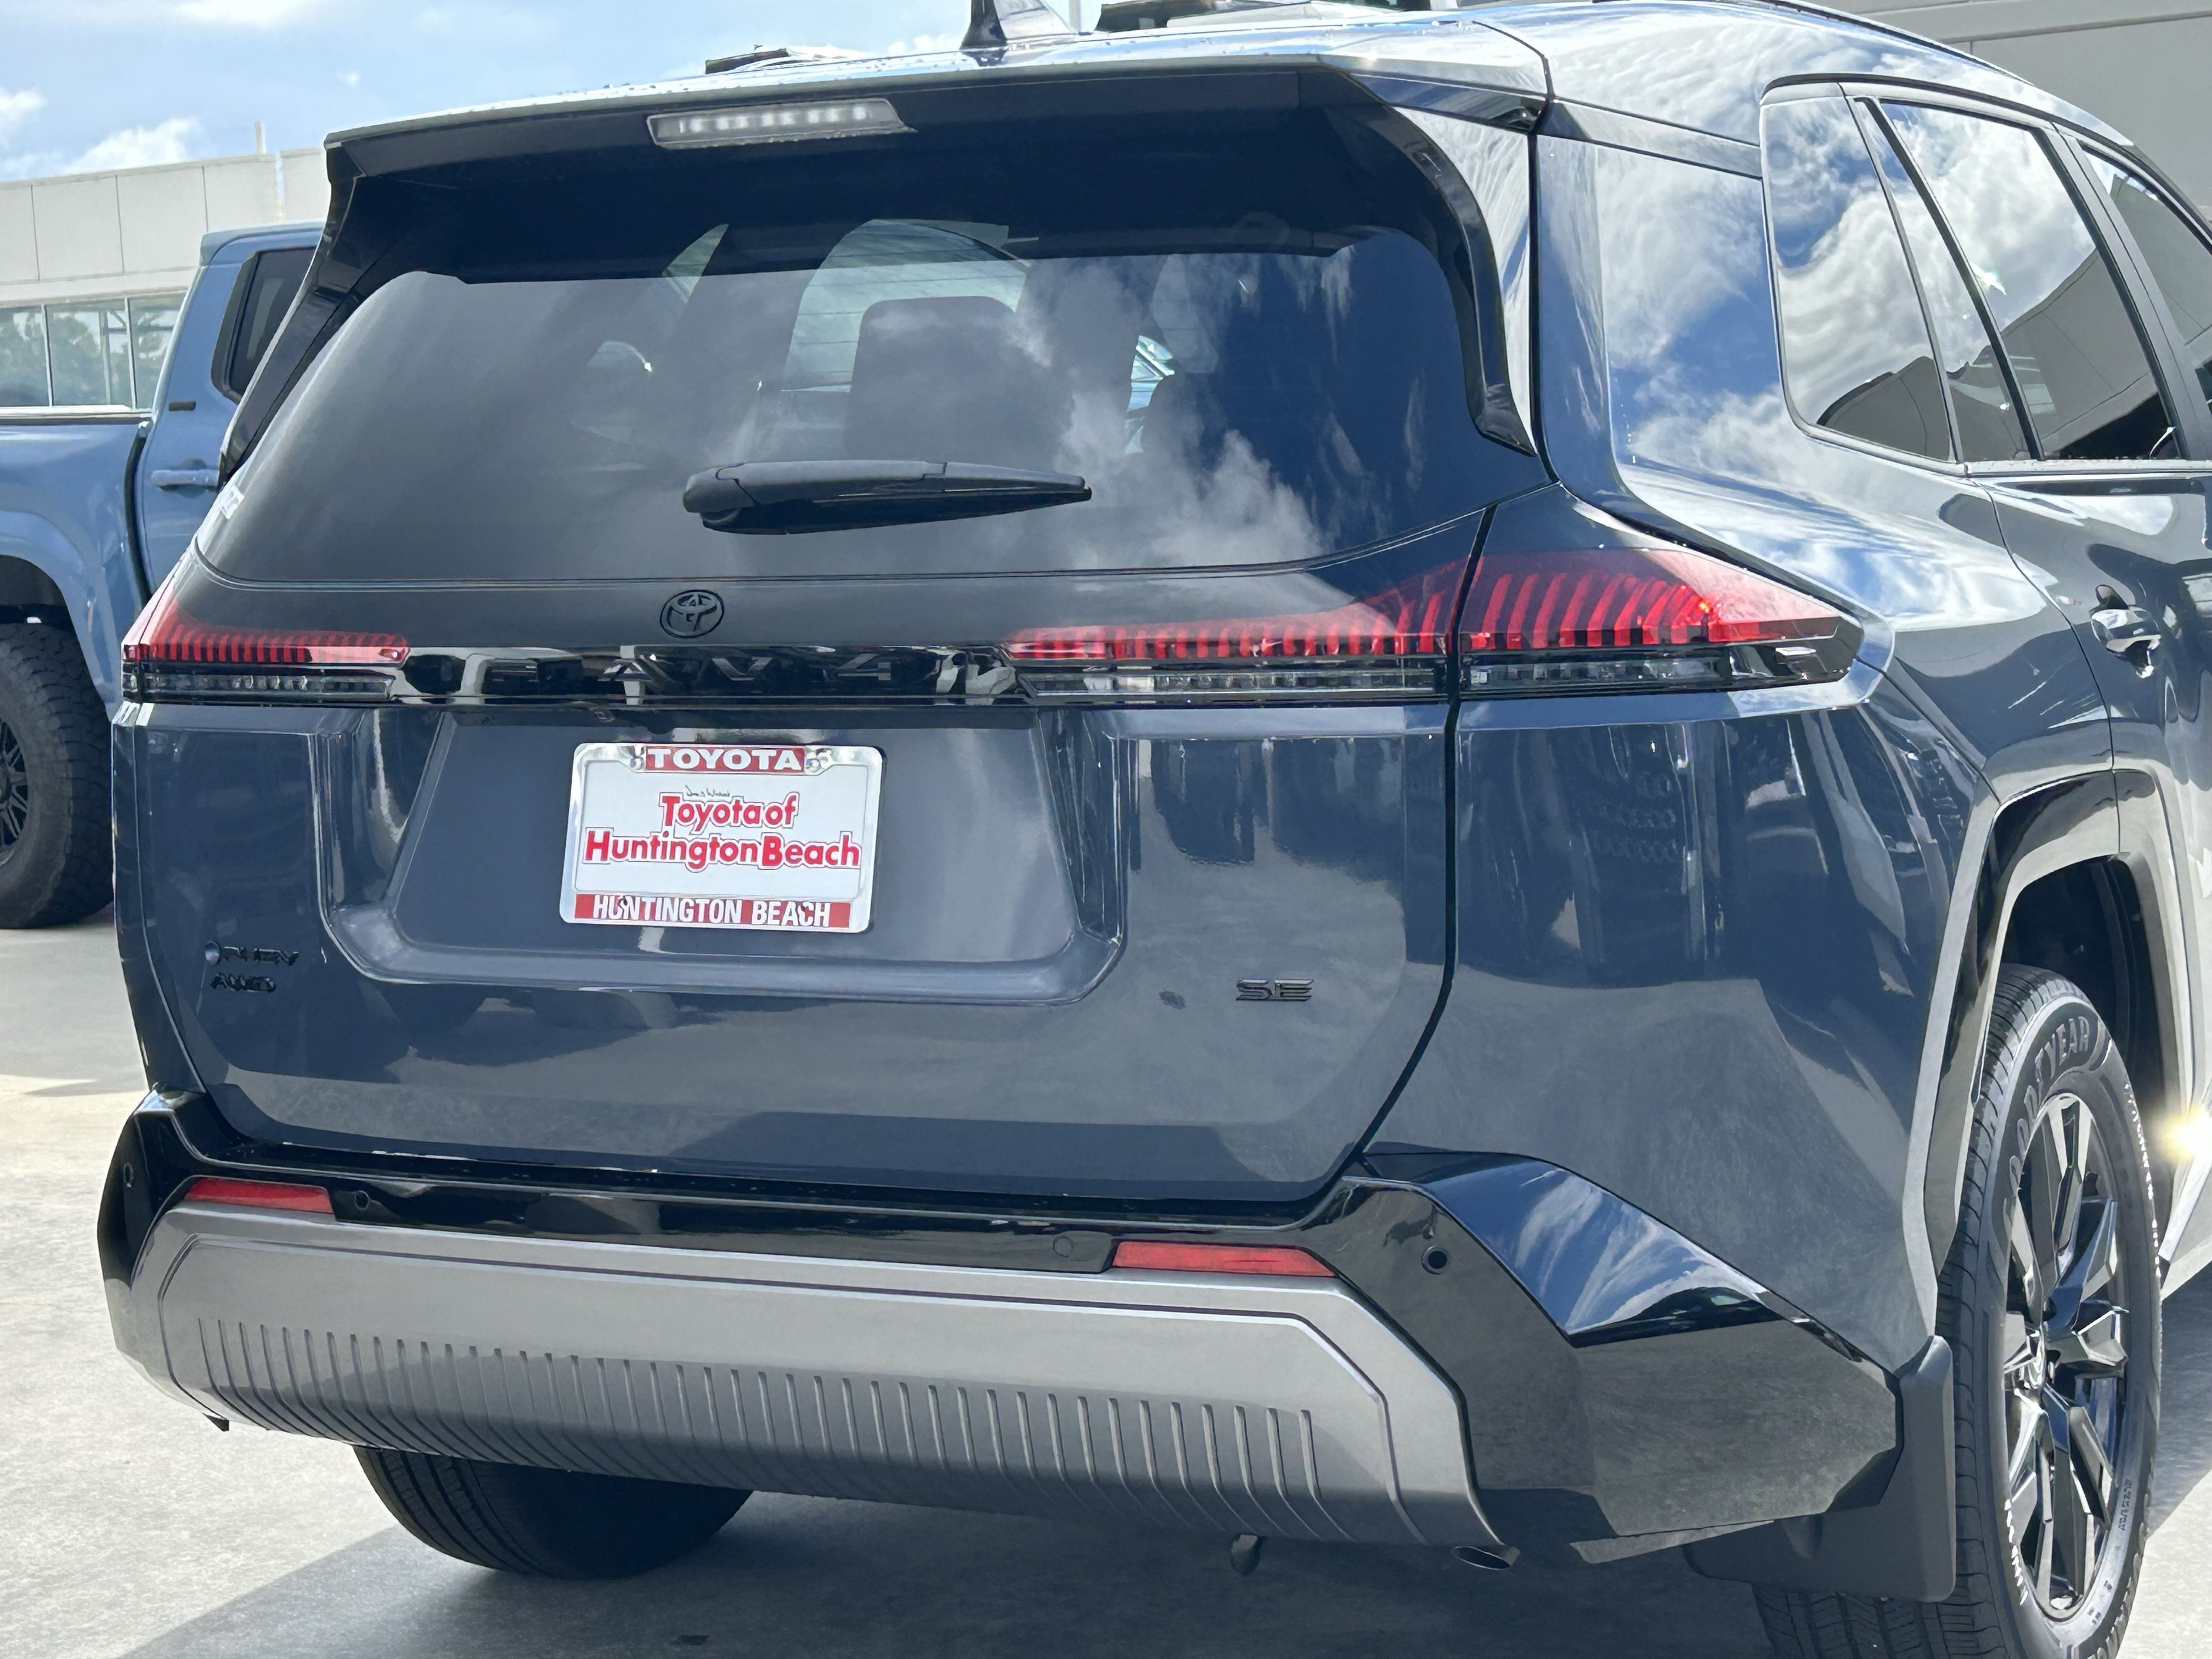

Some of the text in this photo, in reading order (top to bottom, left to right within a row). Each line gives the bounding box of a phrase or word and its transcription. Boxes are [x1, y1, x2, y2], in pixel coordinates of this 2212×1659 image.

[647, 748, 802, 770] TOYOTA
[662, 795, 797, 832] Toyota of
[585, 831, 860, 869] Huntington Beach
[592, 896, 830, 928] HUNTINGTON BEACH
[1236, 979, 1314, 1002] SE
